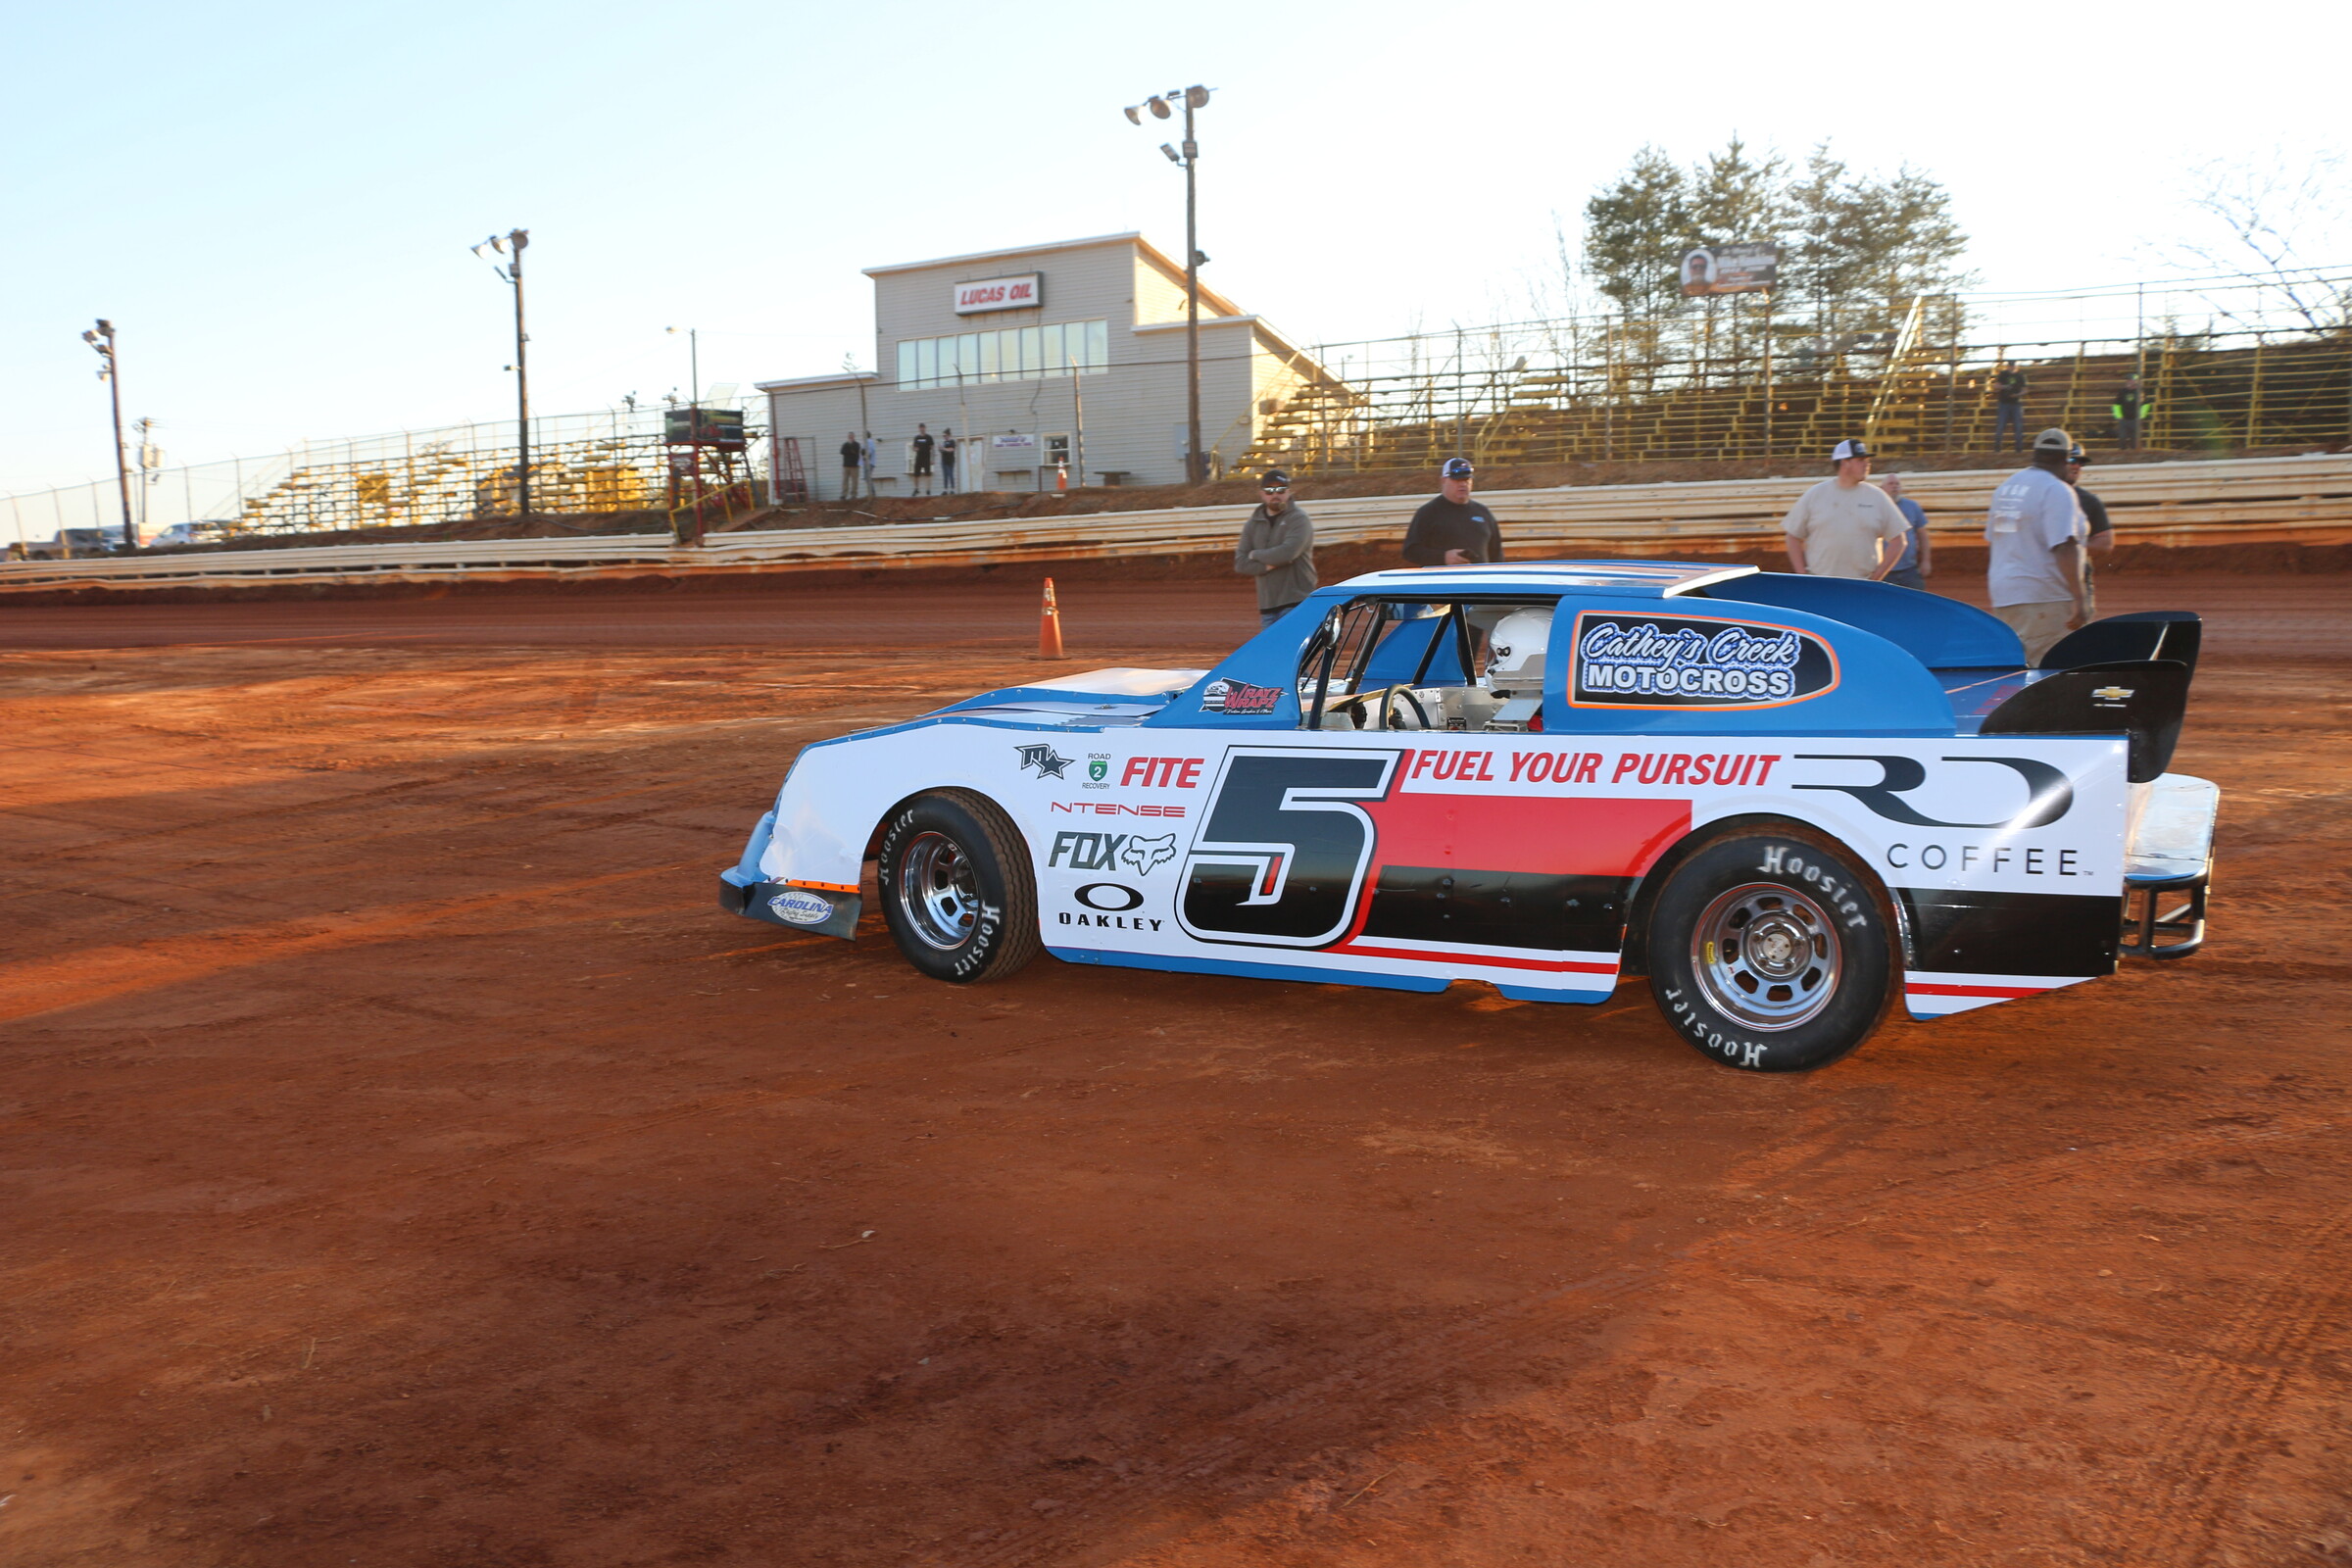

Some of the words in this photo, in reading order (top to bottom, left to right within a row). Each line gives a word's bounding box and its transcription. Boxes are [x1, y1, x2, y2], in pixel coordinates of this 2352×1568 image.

[960, 286, 1005, 305] LUCAS
[1009, 283, 1032, 300] OIL
[1585, 624, 1703, 671] Cathey's
[1710, 628, 1798, 664] Creek
[1587, 664, 1790, 694] MOTOCROSS
[1093, 766, 1102, 778] 2
[1120, 757, 1204, 789] FITE
[1411, 750, 1494, 781] FUEL
[1508, 752, 1602, 783] YOUR
[1611, 753, 1782, 786] PURSUIT
[1051, 802, 1186, 817] NTENSE
[879, 809, 913, 886] Hoosier
[1048, 831, 1128, 871] FOX
[1174, 745, 1404, 951] 5
[1887, 843, 2078, 876] COFFEE
[1756, 845, 1868, 928] Hoosier
[768, 897, 833, 914] CAROLINA
[1058, 912, 1162, 931] OAKLEY
[955, 899, 1001, 976] Hoosier
[1665, 987, 1768, 1068] Hoosier
